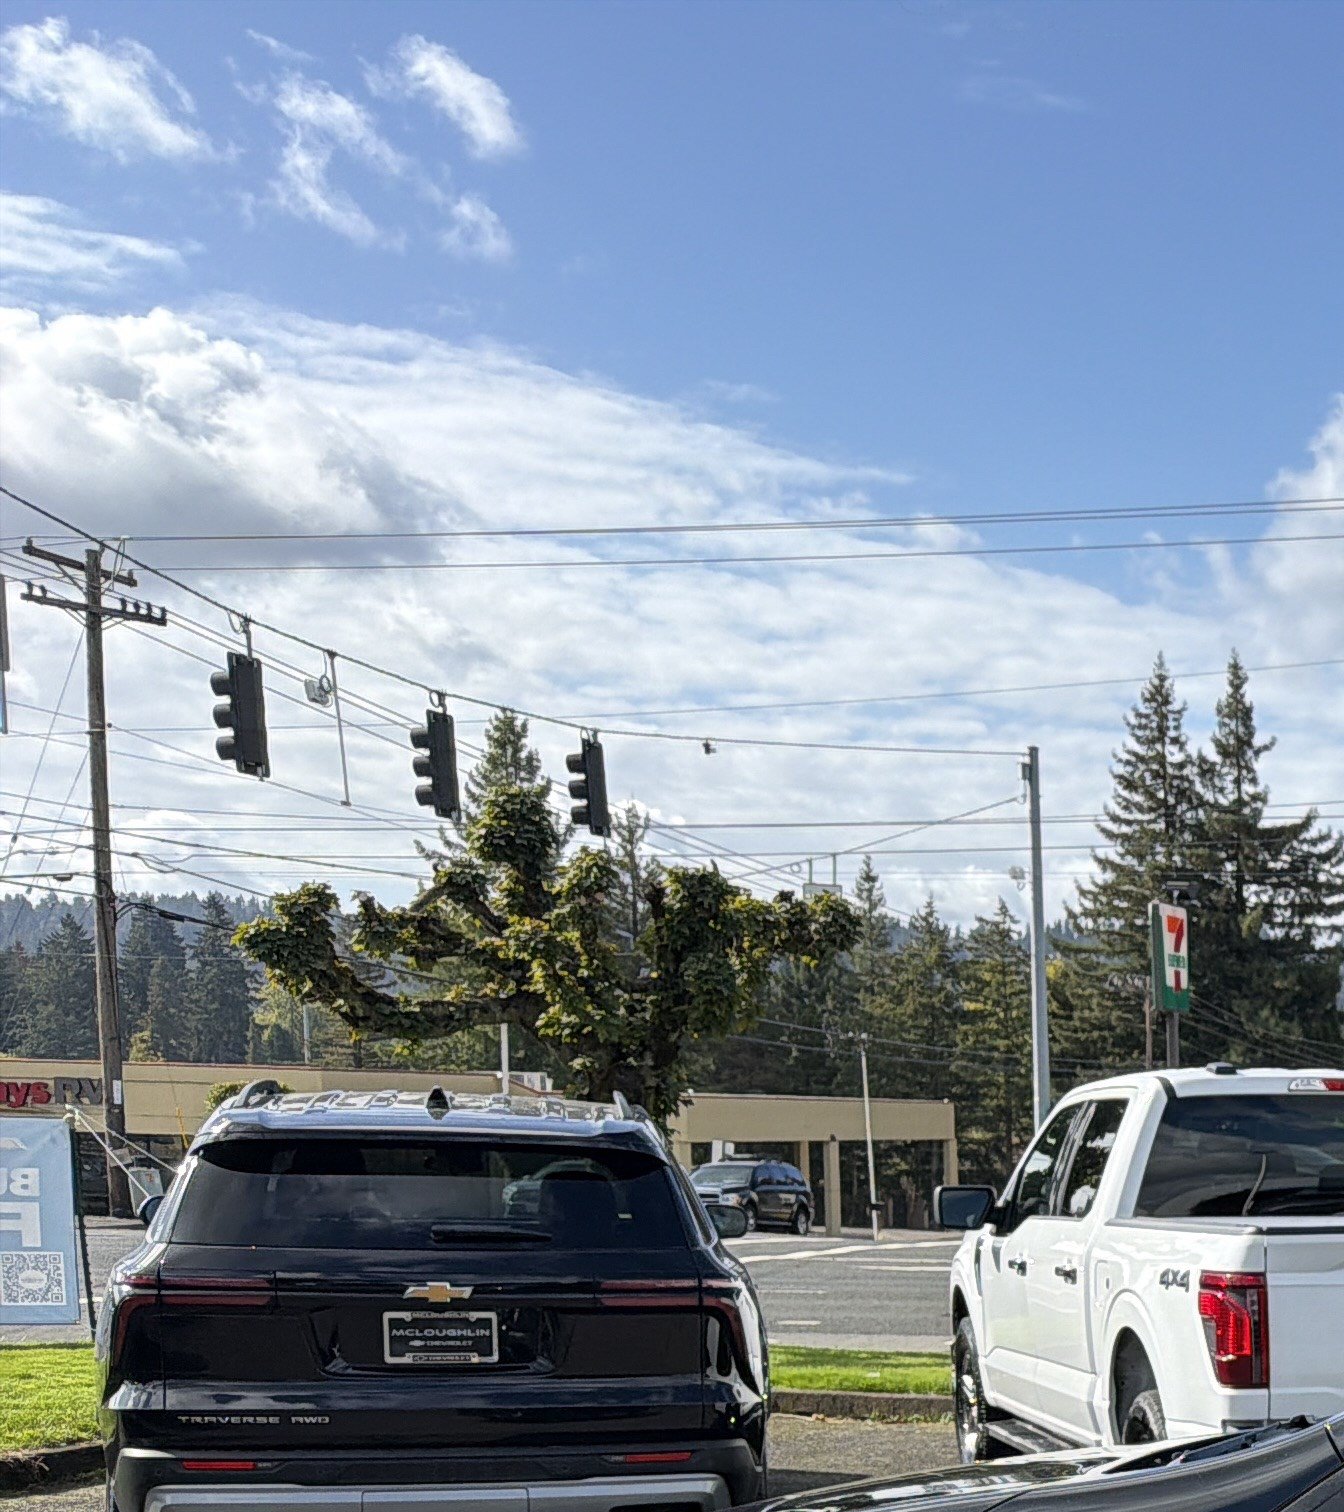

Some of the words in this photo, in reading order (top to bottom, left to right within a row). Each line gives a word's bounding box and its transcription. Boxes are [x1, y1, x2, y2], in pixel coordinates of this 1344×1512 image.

[54, 1077, 102, 1105] RV
[391, 1328, 490, 1337] MCLOUGHLIN
[177, 1416, 280, 1424] TRAVERSE
[291, 1416, 330, 1424] AWD
